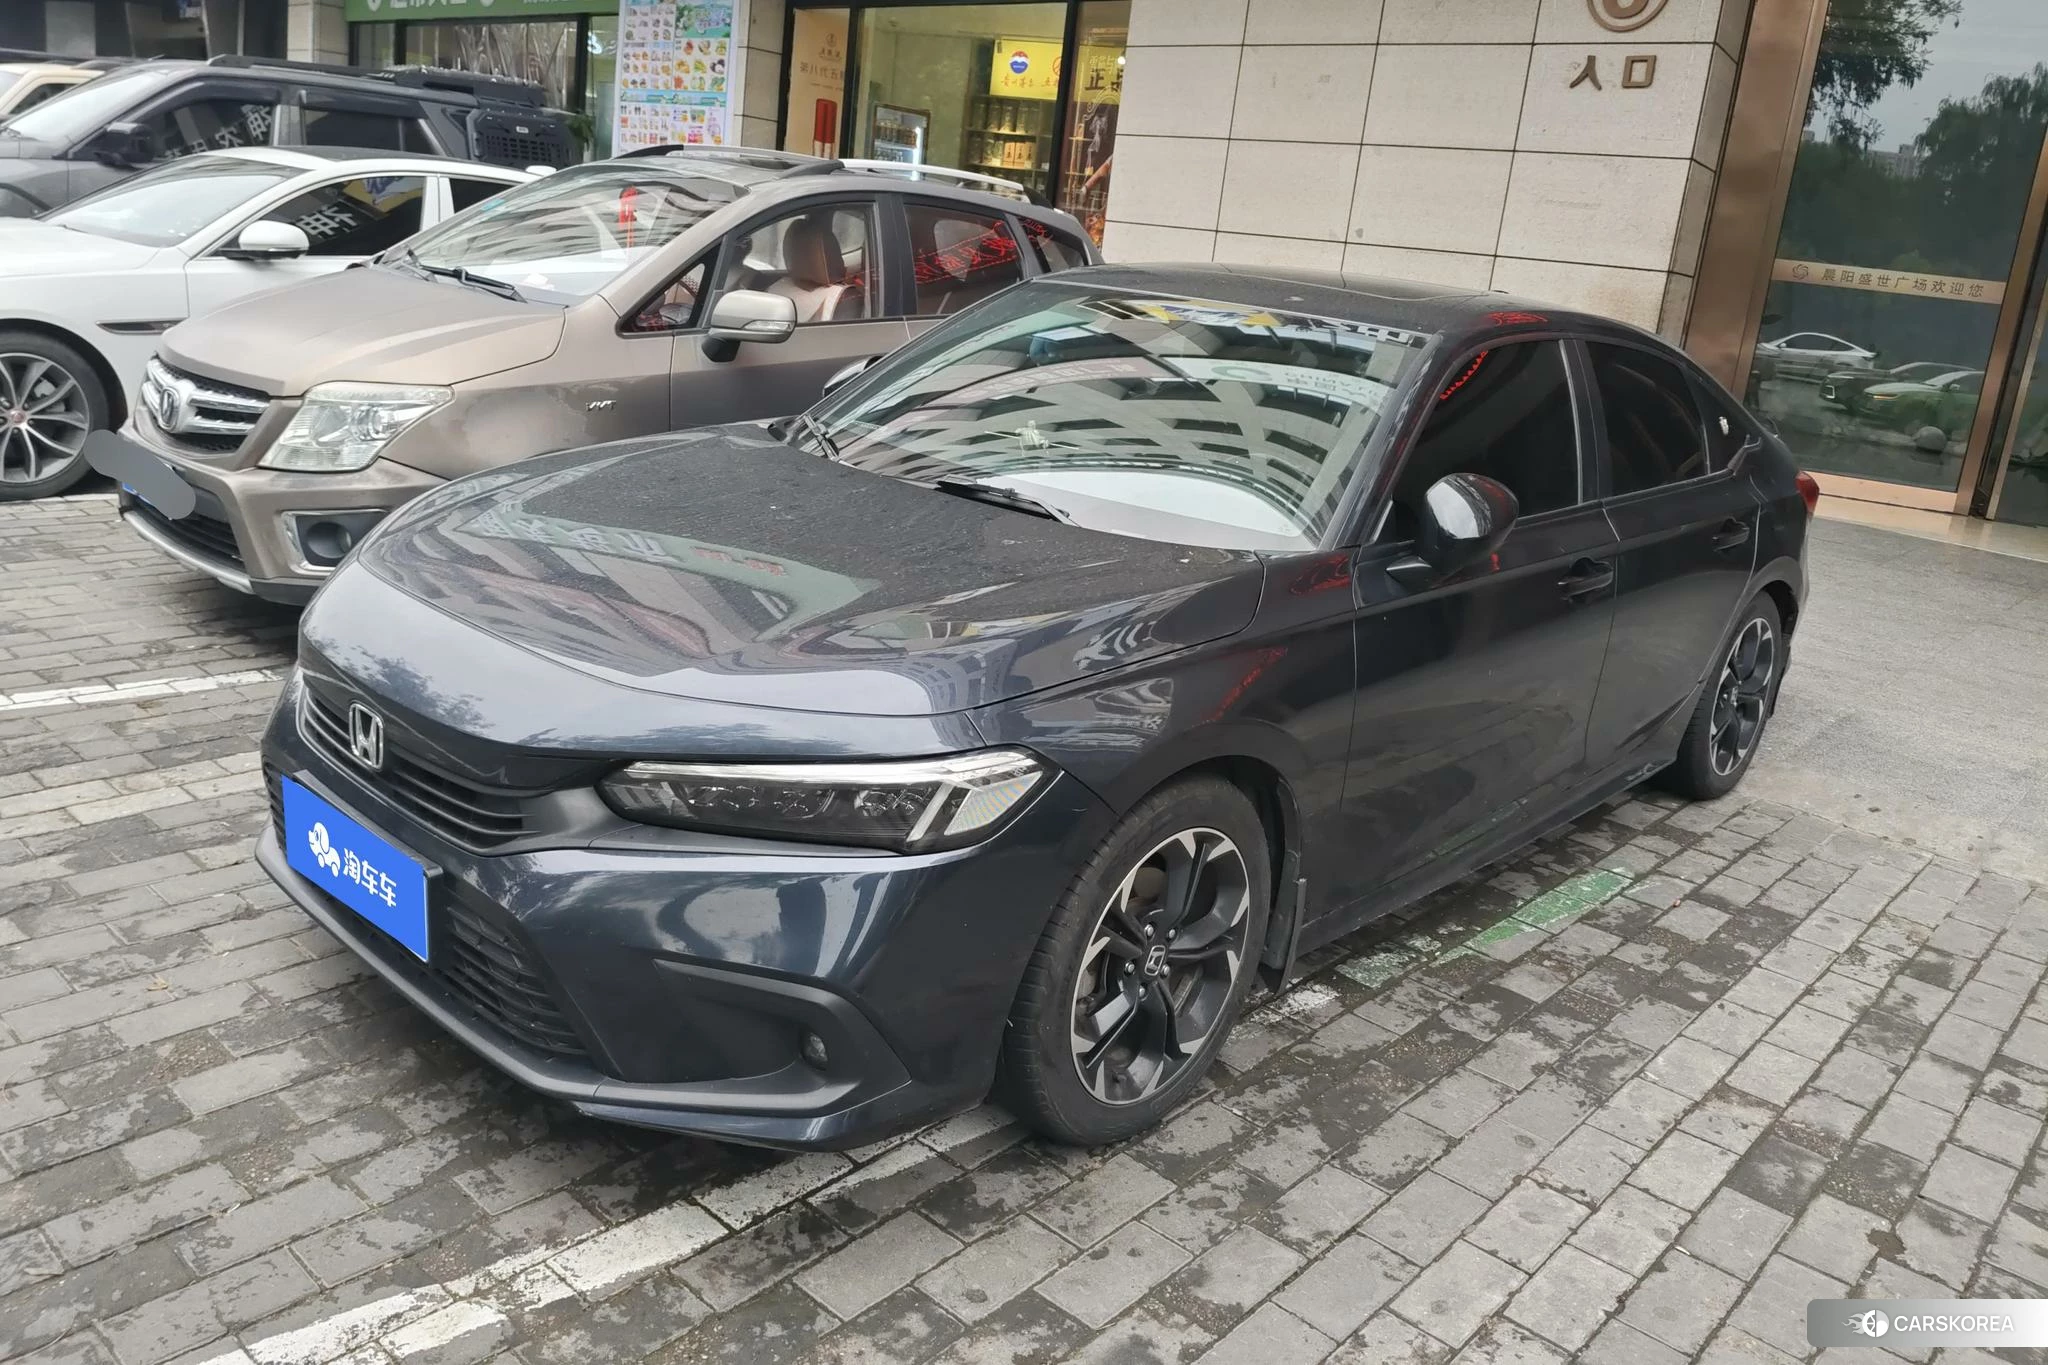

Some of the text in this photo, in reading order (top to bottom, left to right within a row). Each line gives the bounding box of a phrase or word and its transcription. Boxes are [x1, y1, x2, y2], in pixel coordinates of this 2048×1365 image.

[1569, 54, 1657, 90] 入口
[1821, 267, 1985, 298] 晨阳盛世广场欢迎您
